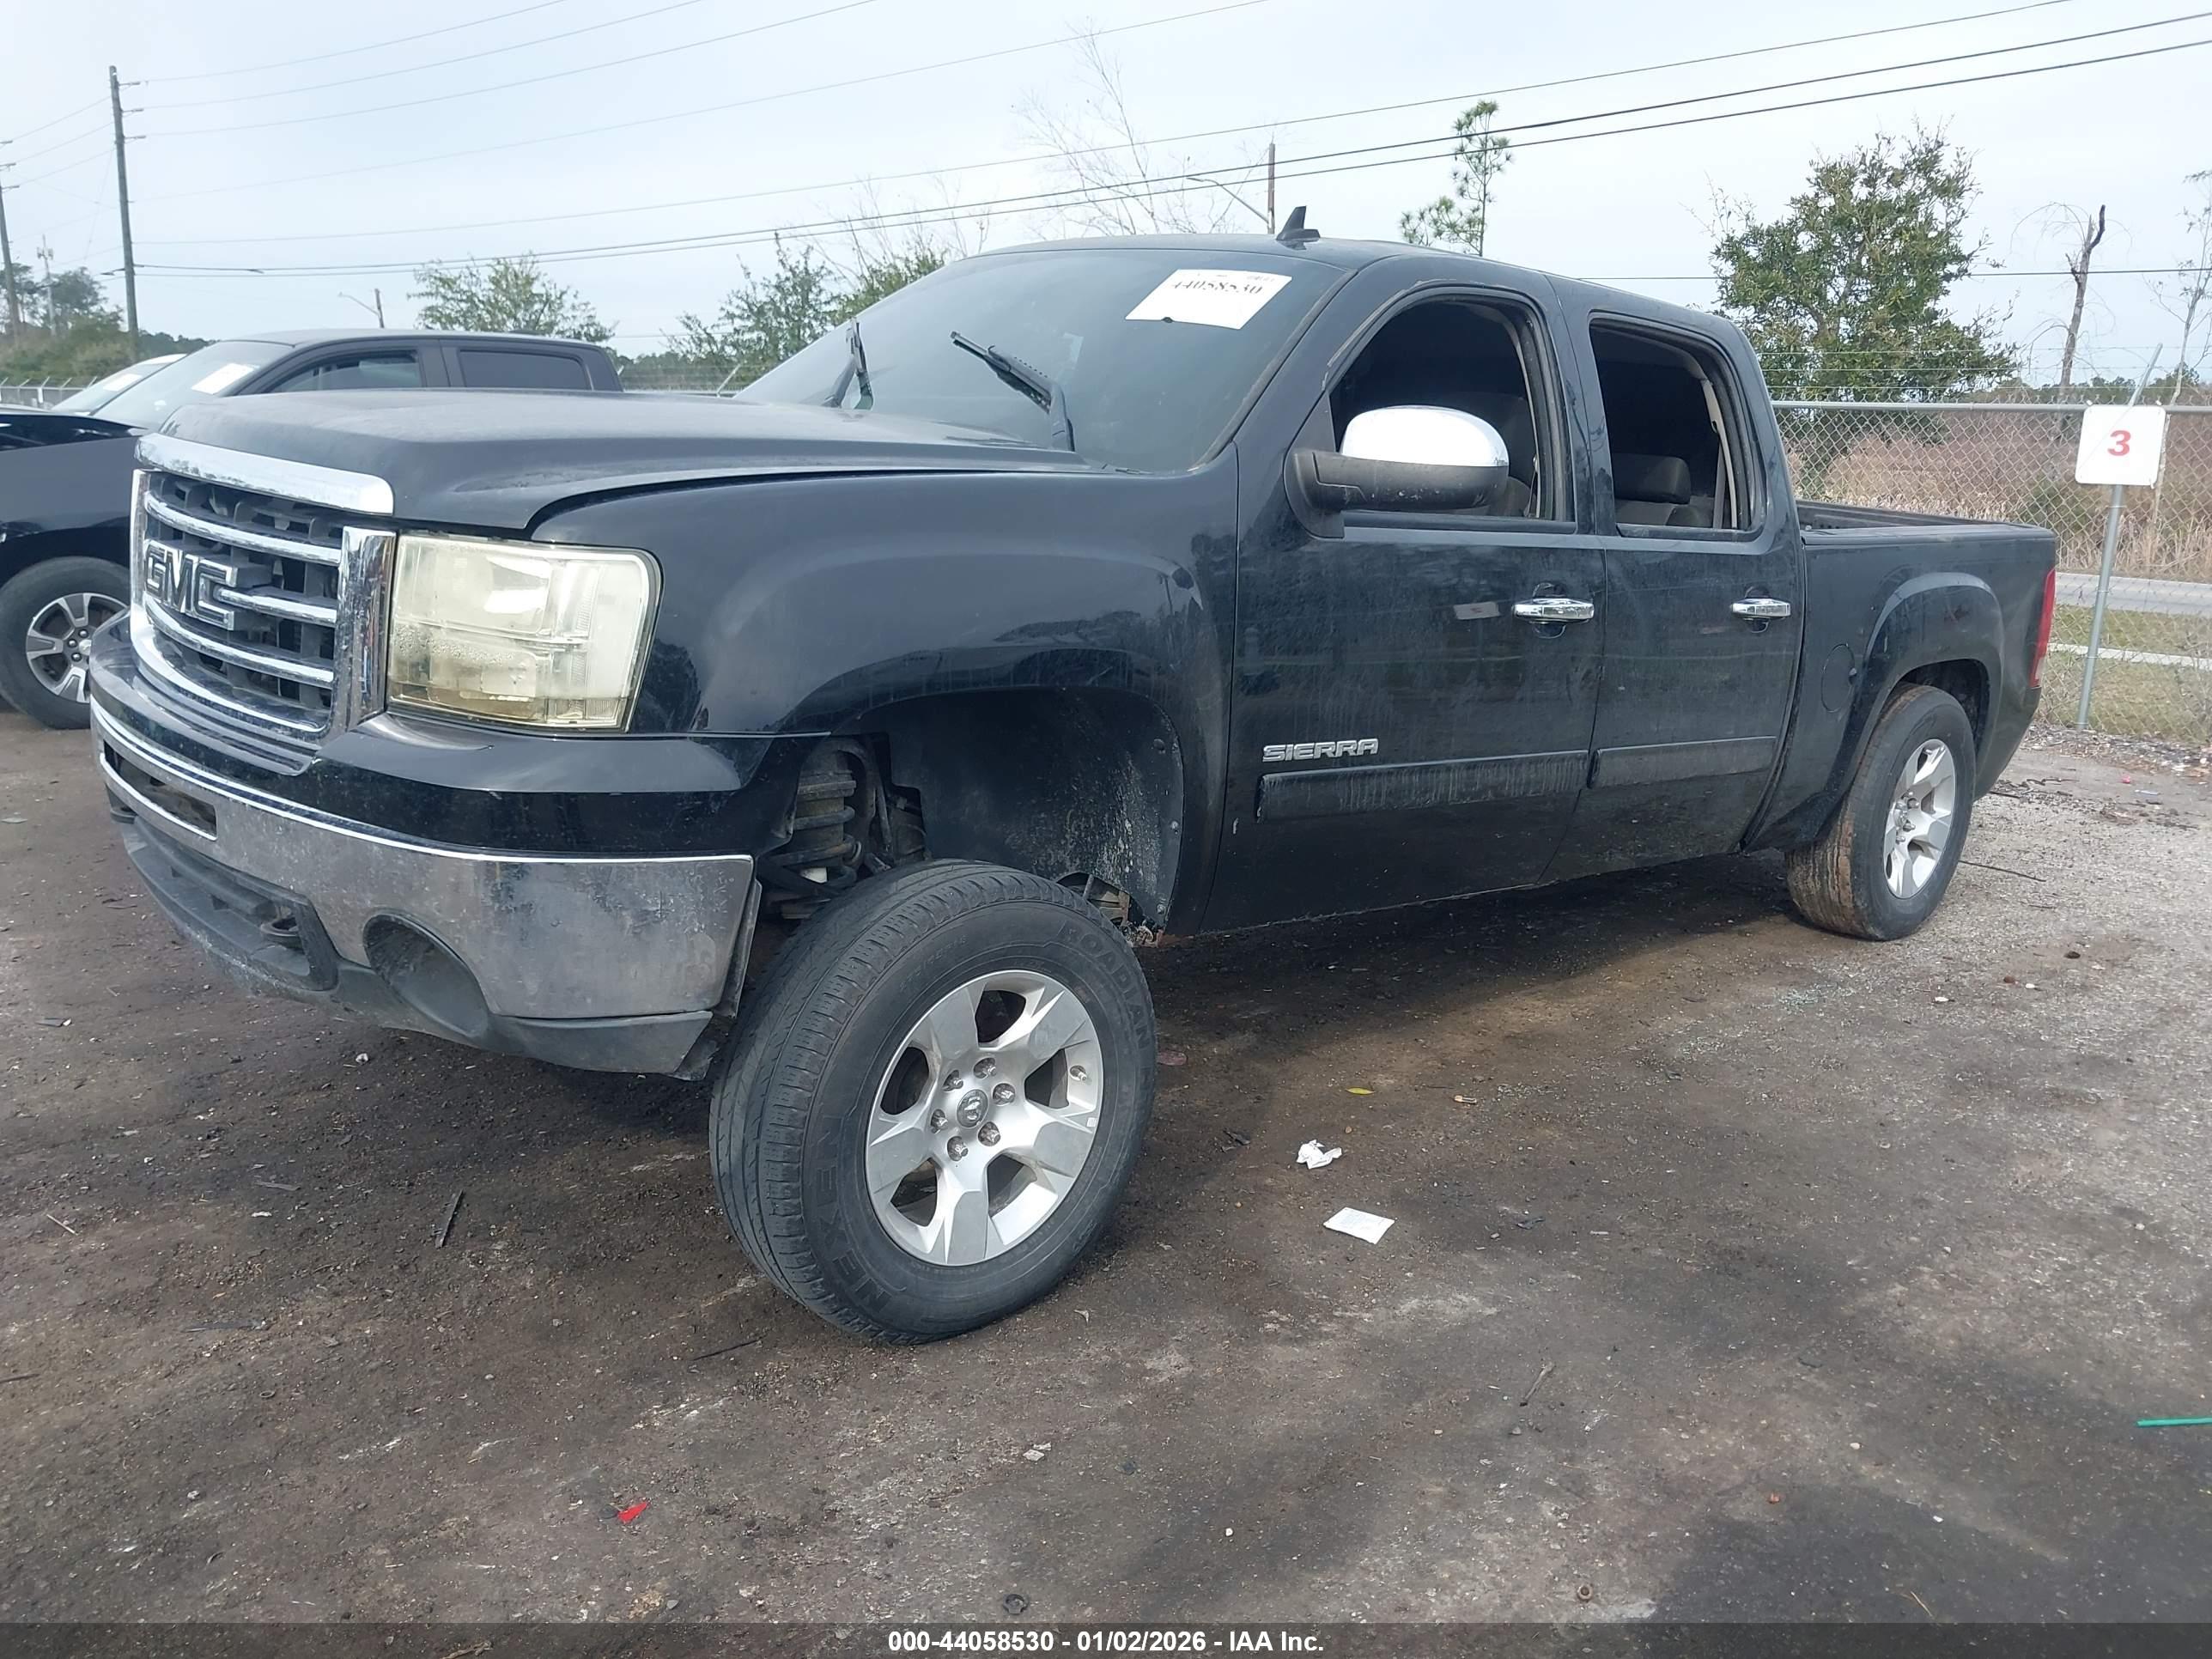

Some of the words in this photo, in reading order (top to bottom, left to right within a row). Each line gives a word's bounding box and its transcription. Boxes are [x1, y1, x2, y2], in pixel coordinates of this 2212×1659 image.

[2107, 429, 2131, 457] 3
[143, 538, 238, 631] GMC
[1261, 738, 1379, 763] SIERRA
